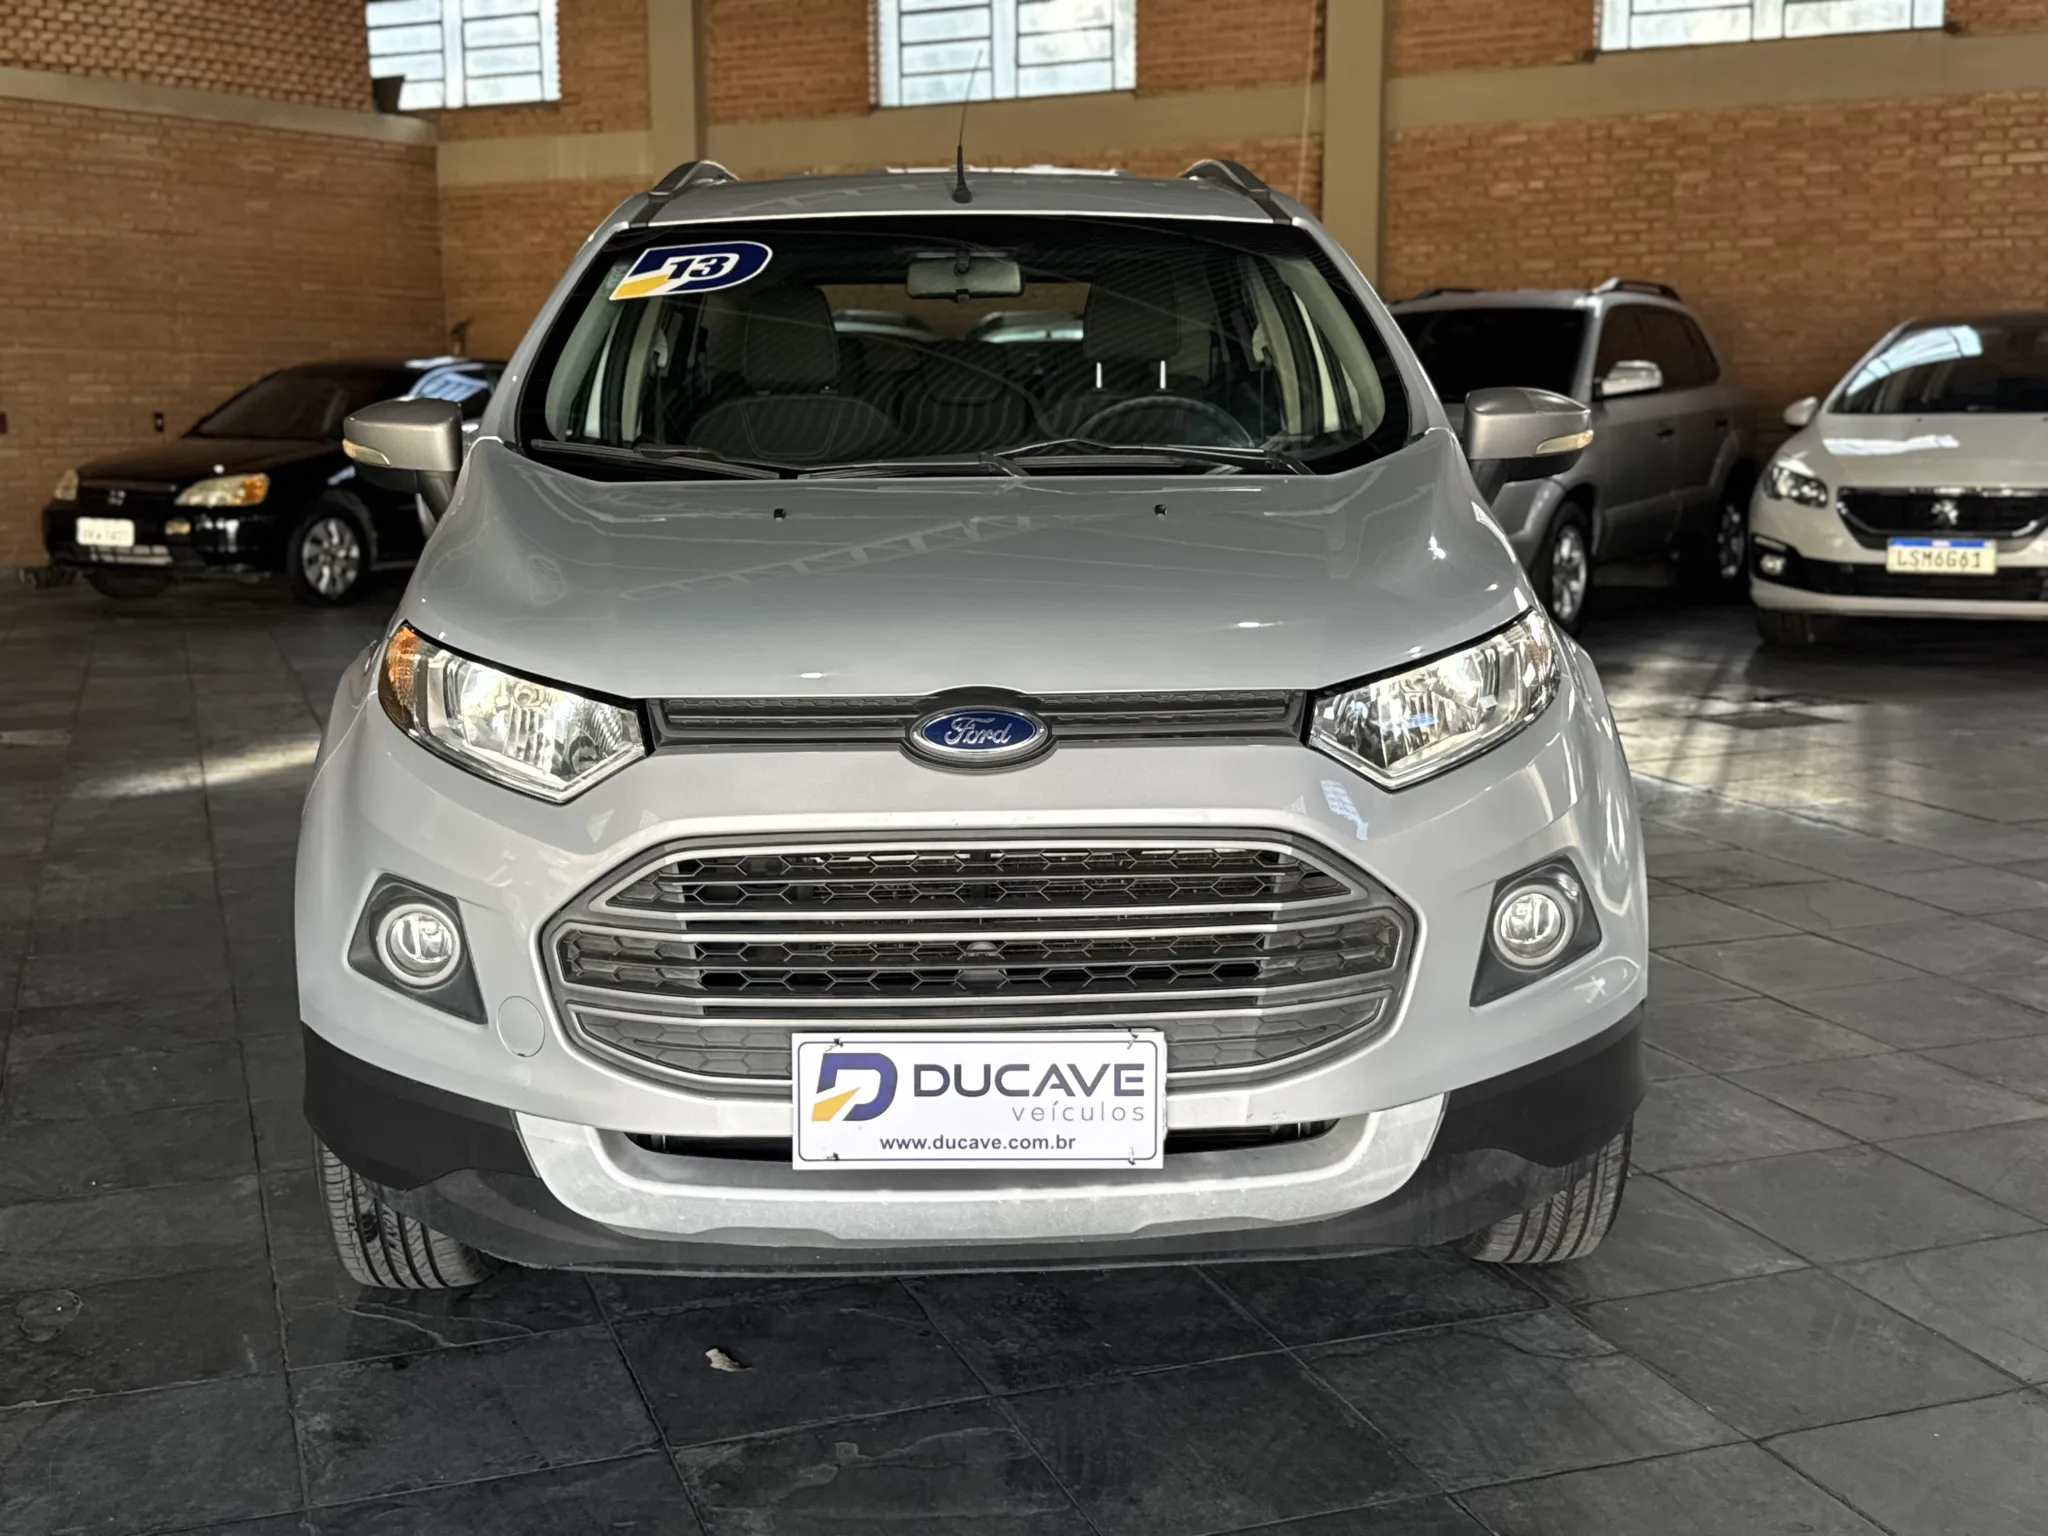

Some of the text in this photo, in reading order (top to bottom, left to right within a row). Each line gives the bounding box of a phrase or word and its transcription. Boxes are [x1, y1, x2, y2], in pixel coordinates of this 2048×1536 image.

[667, 255, 731, 280] 13
[1896, 550, 1982, 568] LSM6G61
[943, 716, 1013, 745] Ford
[913, 1063, 1145, 1097] DUCAVE
[1011, 1100, 1145, 1121] veículos
[879, 1134, 1076, 1150] www.ducave.com.br
